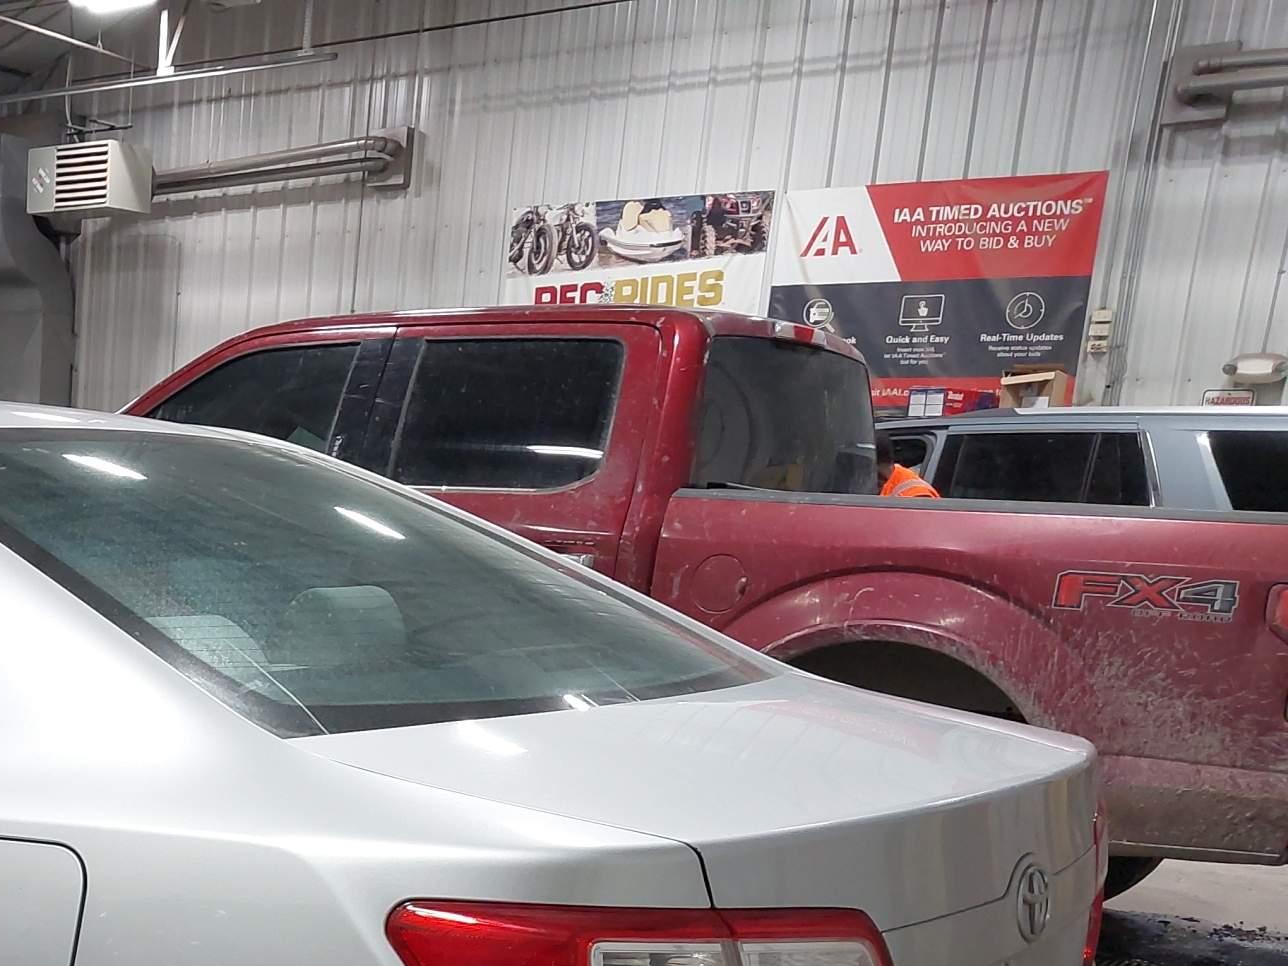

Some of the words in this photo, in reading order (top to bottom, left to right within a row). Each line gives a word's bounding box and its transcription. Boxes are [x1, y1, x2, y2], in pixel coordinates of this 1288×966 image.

[894, 206, 924, 224] IAA
[929, 204, 983, 222] TIMED
[911, 220, 1012, 238] INTRODUCING
[1016, 220, 1028, 233] A
[1032, 218, 1069, 232] NEW
[920, 238, 951, 252] WAY
[956, 237, 975, 250] TO
[979, 236, 1004, 249] BID
[1008, 236, 1020, 249] &
[1024, 234, 1056, 248] BUY
[614, 269, 724, 307] RIDES
[885, 335, 910, 344] Quick
[911, 335, 929, 343] and
[929, 334, 950, 344] Easy
[980, 333, 1024, 342] Real-Time
[1025, 332, 1065, 343] Updates
[1051, 569, 1240, 616] FX4
